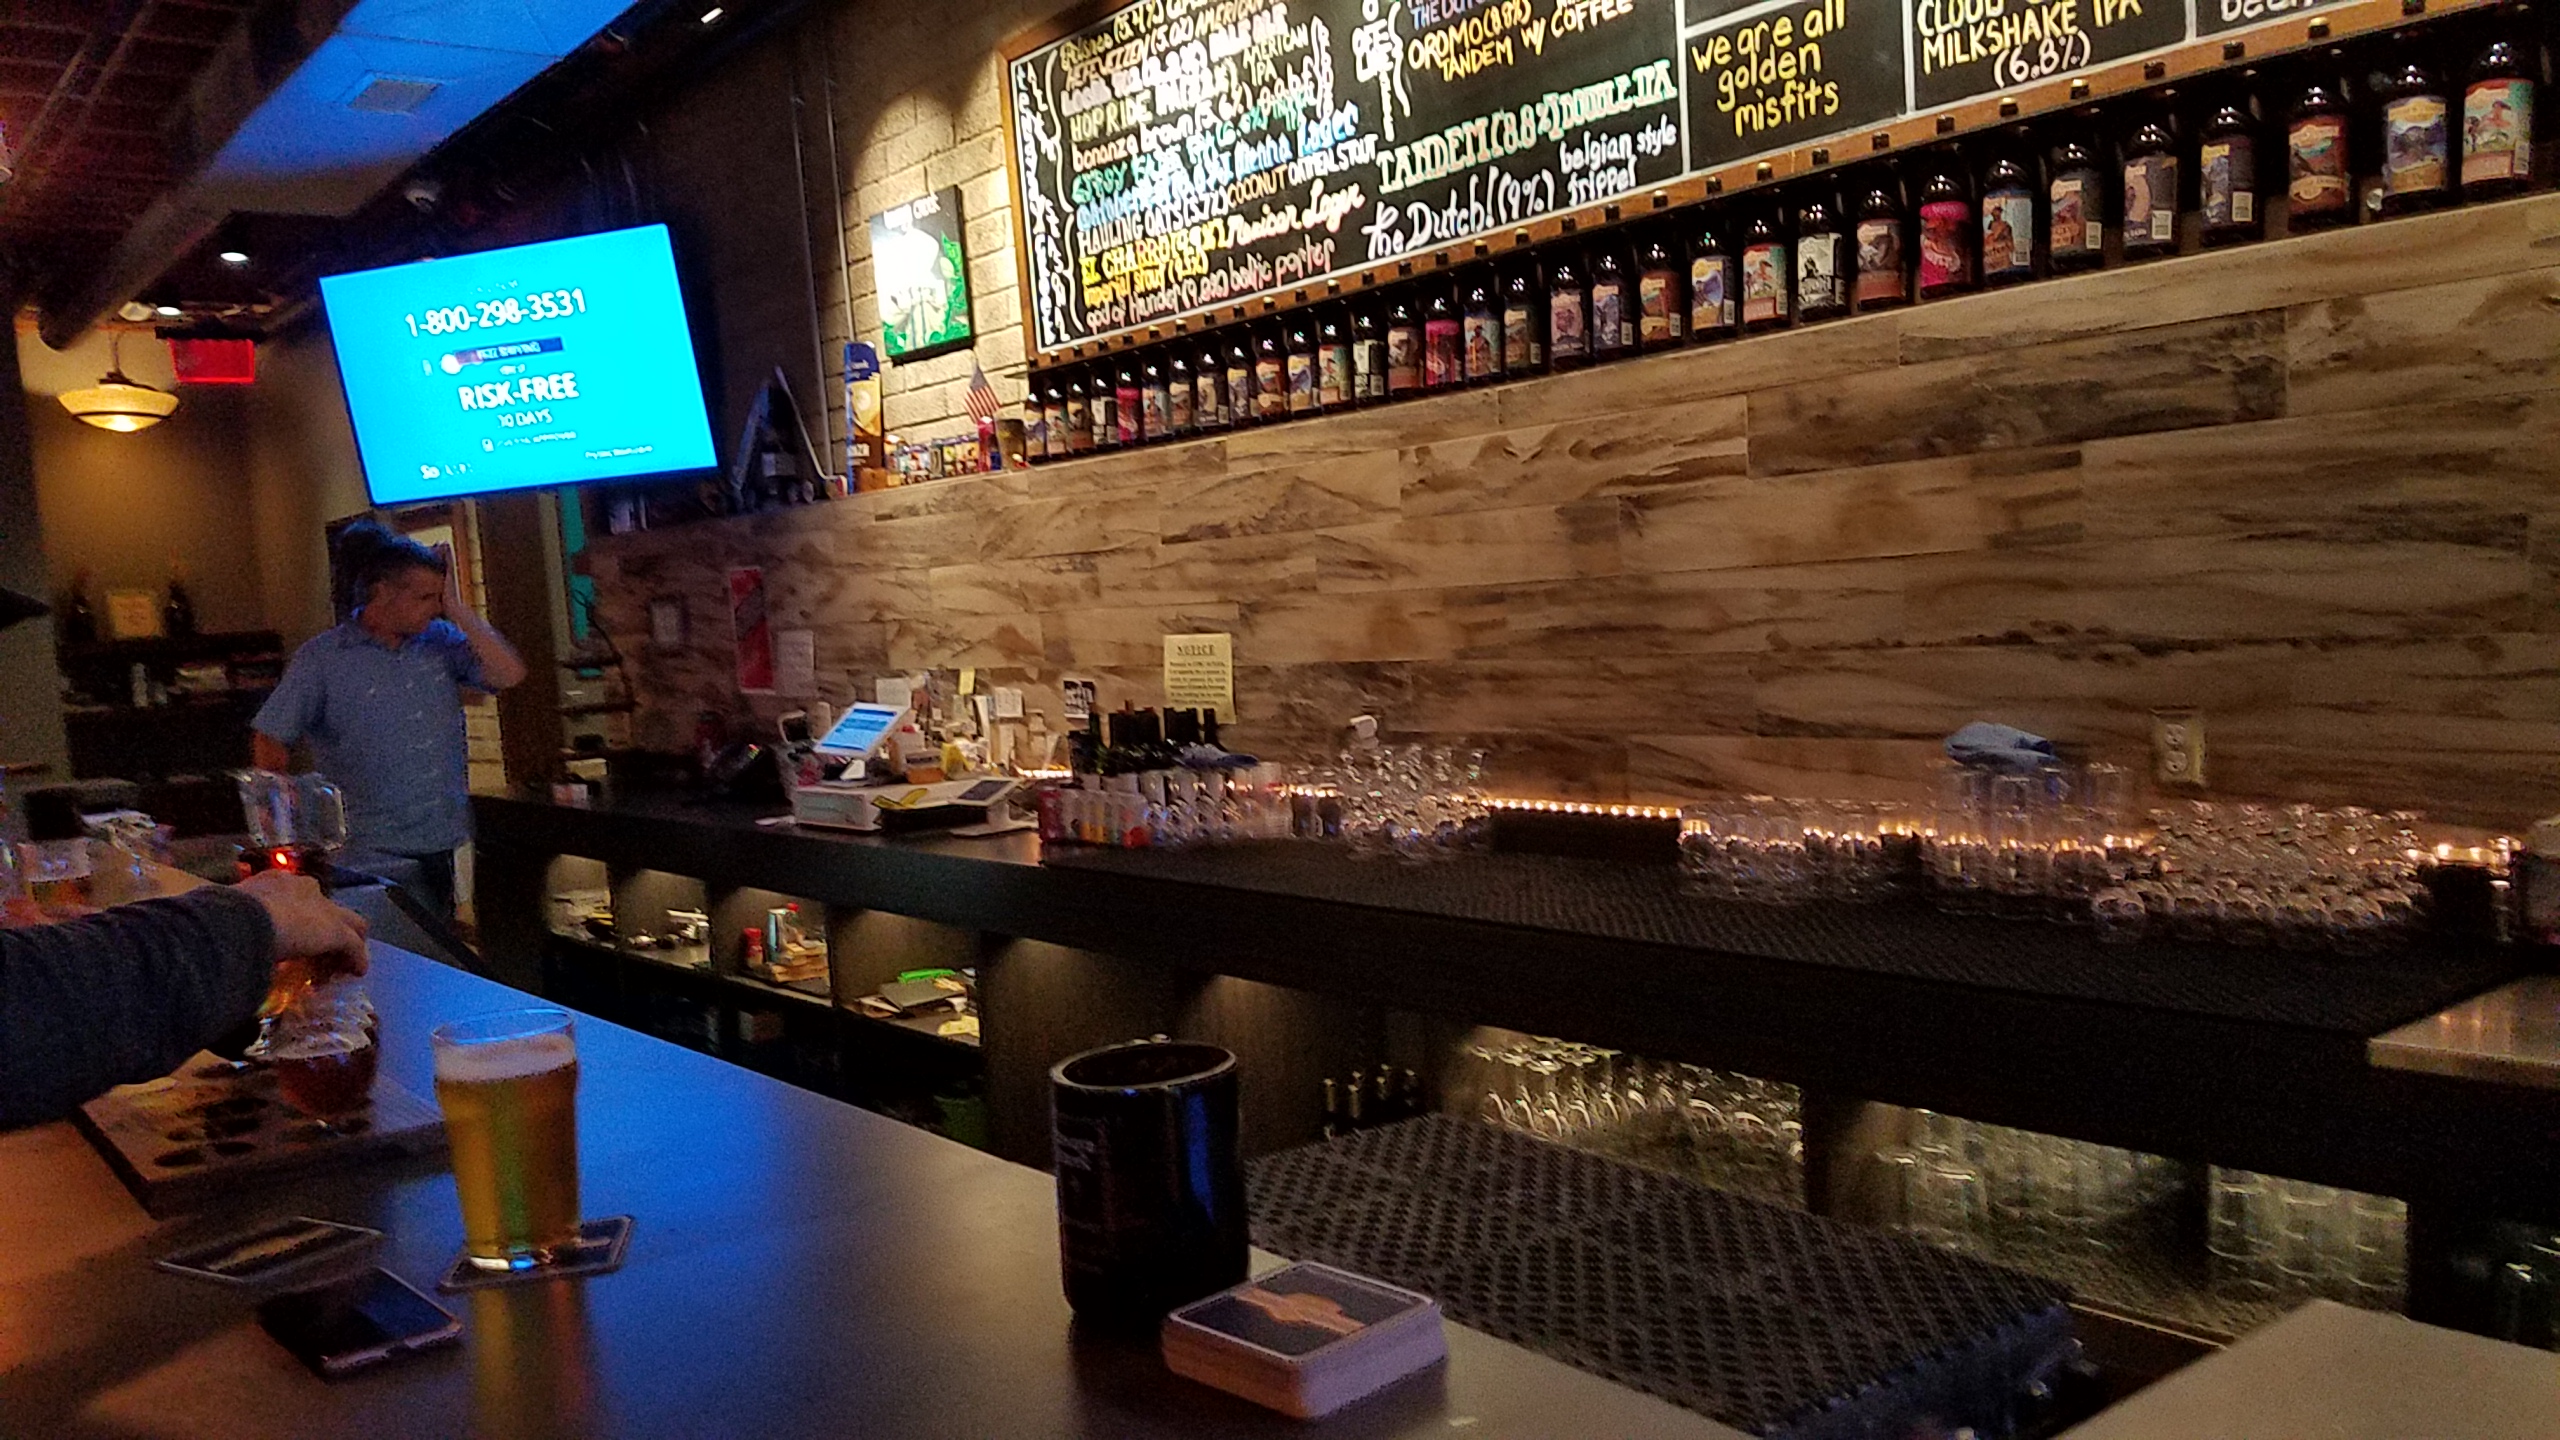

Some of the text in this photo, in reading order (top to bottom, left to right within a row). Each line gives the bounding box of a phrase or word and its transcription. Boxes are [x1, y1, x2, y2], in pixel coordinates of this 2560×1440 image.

[1408, 18, 1484, 70] OROMO
[1551, 0, 1633, 38] COFFEE
[1692, 0, 1845, 73] we are all
[1923, 0, 2080, 75] MILKSHAKE
[1441, 35, 1514, 82] TANDEM
[1717, 43, 1822, 113] golden
[1993, 30, 2091, 88] (6.8%)
[1734, 78, 1840, 138] misfits
[1375, 117, 1492, 195] TANDEM
[1560, 113, 1677, 174] belgian style
[1077, 212, 1144, 259] HAULING
[1227, 164, 1288, 208] COCONUT
[1498, 170, 1556, 225] (9%)
[404, 287, 586, 337] 1-800-298-3531
[457, 372, 580, 411] RISK-FREE
[515, 408, 553, 426] DAYS
